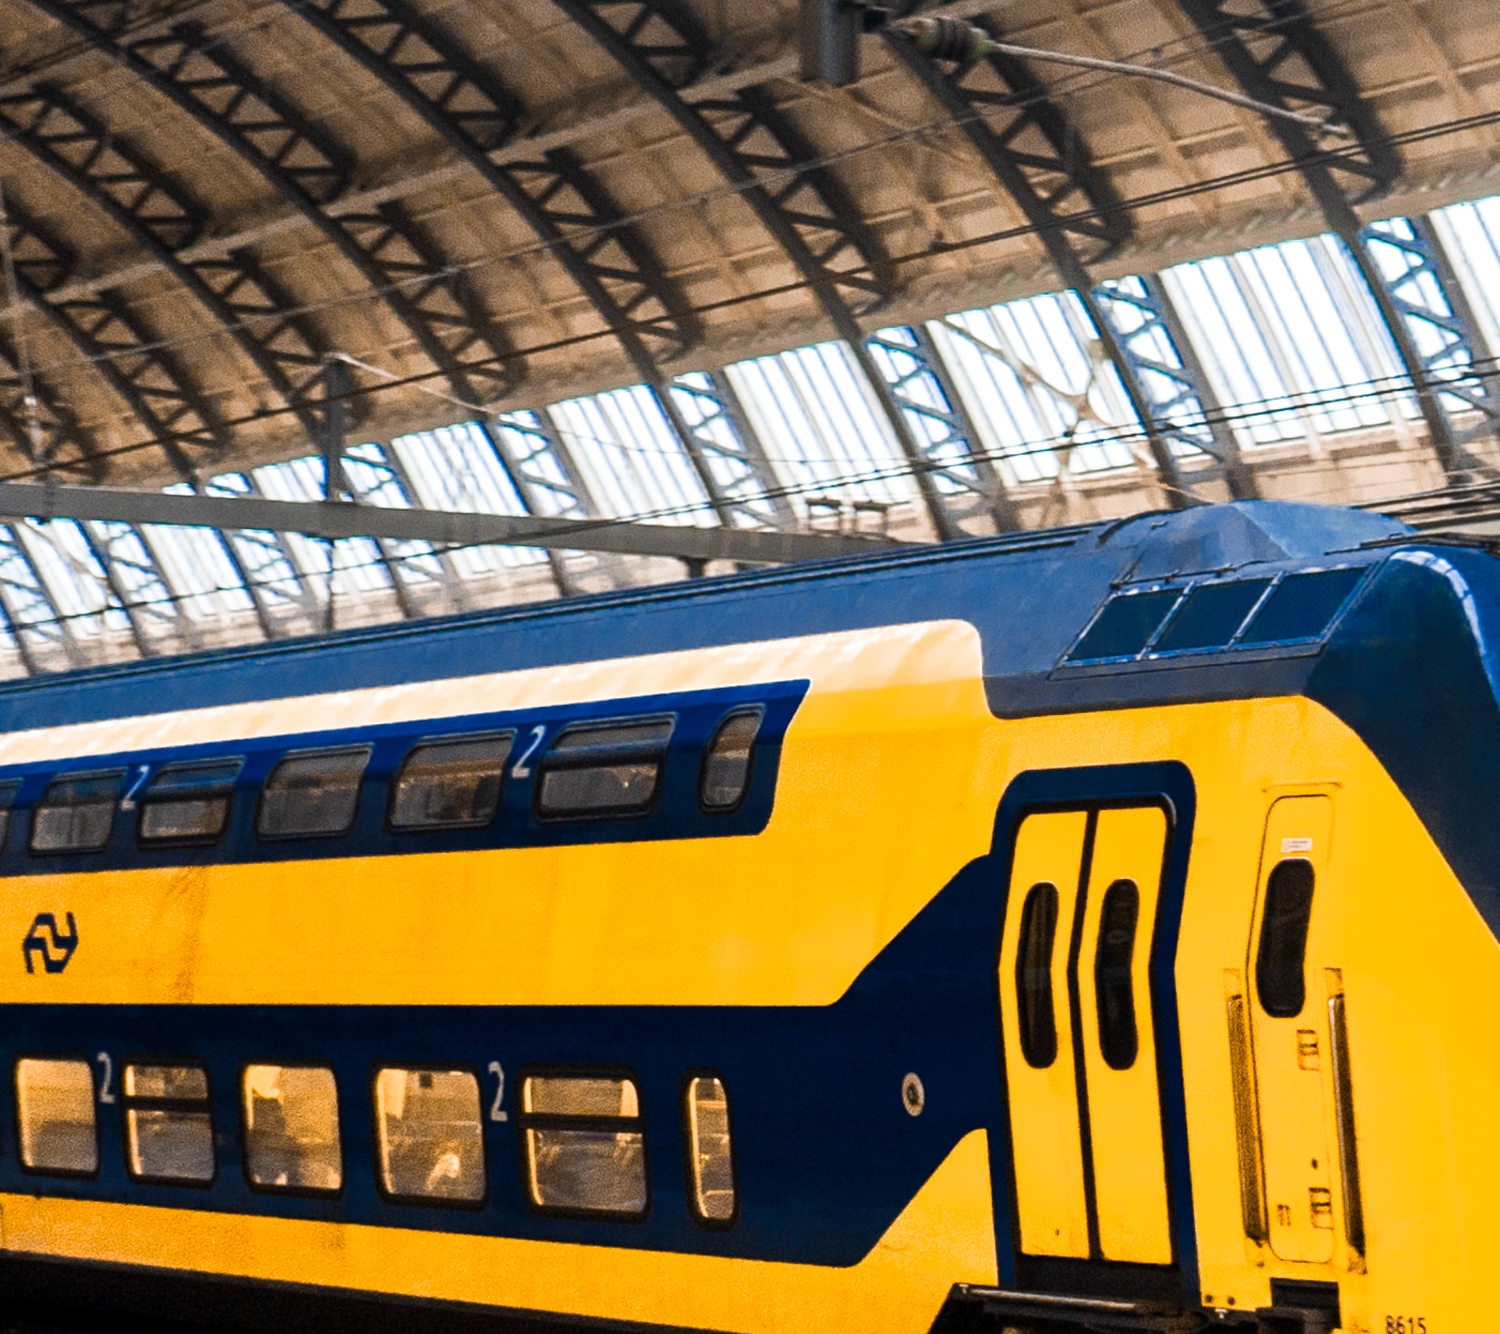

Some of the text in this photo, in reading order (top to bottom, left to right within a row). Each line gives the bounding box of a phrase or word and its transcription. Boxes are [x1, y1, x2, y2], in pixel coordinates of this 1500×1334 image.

[512, 724, 546, 778] 2
[121, 764, 150, 810] 2
[97, 1052, 115, 1103] 2
[488, 1061, 508, 1121] 2
